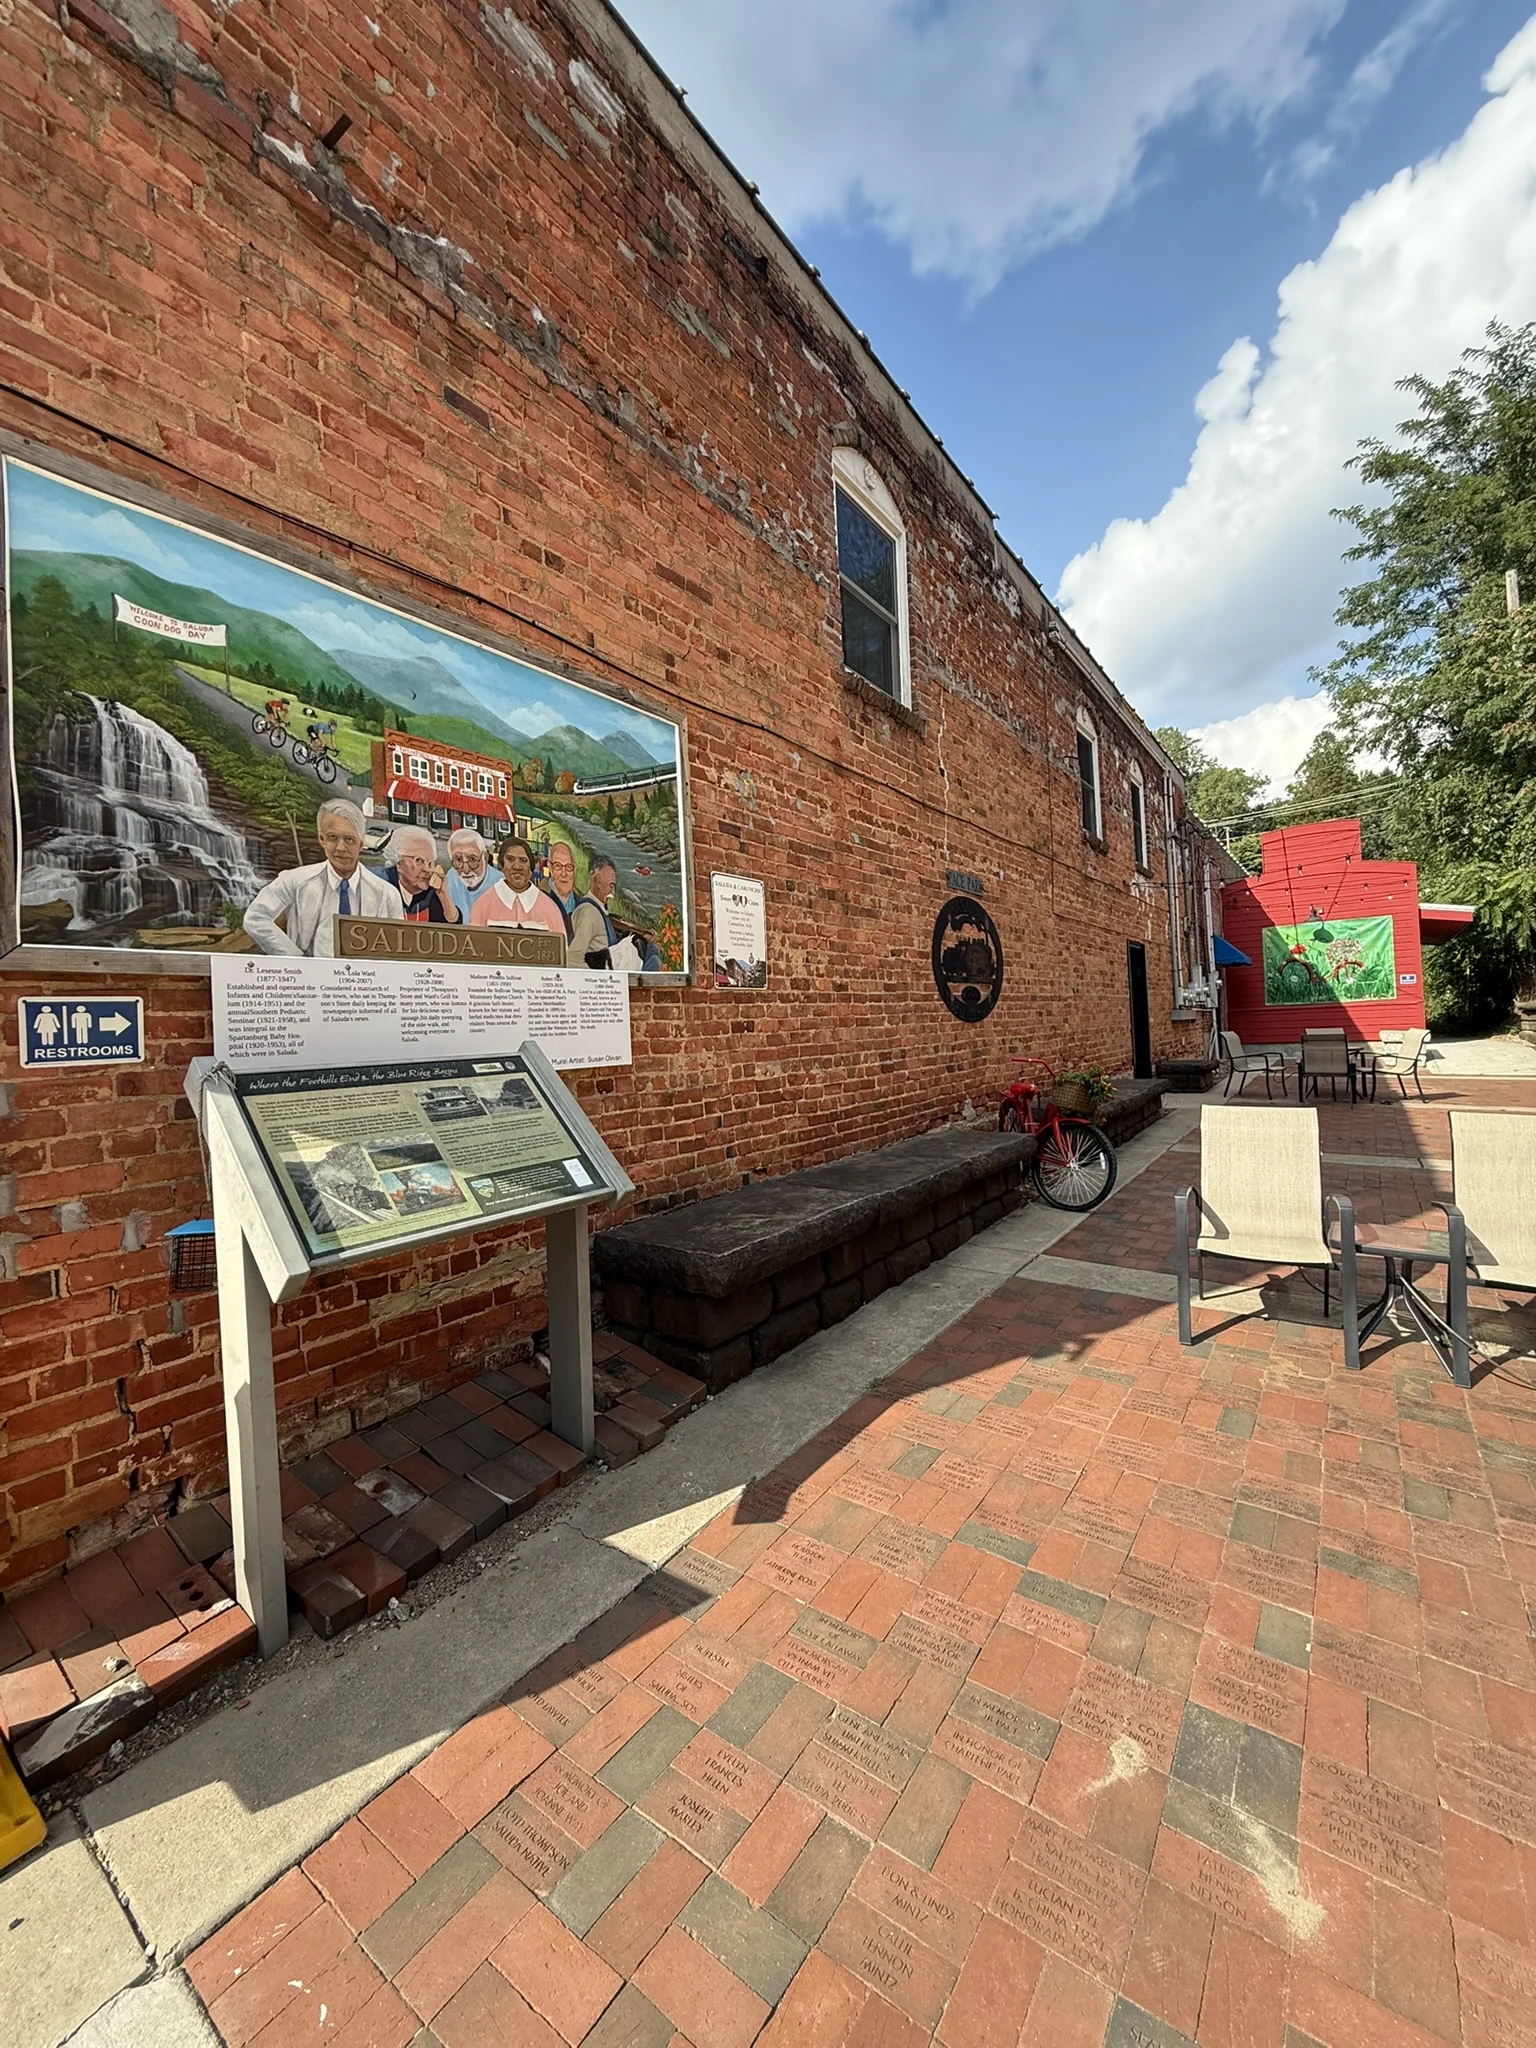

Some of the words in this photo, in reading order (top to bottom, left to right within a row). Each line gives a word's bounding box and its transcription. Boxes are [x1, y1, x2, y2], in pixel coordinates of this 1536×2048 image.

[129, 604, 164, 622] WELCOME
[170, 619, 178, 627] TO
[182, 622, 214, 633] SALUDA
[134, 615, 161, 630] COON
[164, 625, 181, 635] DOG
[188, 631, 206, 640] DAY
[950, 871, 966, 888] PACE
[967, 874, 984, 893] PARK
[349, 924, 485, 961] SALUDA,
[498, 935, 535, 961] NC
[243, 1025, 268, 1033] integral
[34, 1044, 134, 1059] RESTROOMS
[229, 1050, 250, 1058] which
[587, 1055, 604, 1063] Susan
[250, 1077, 278, 1090] Where
[282, 1076, 296, 1088] the
[300, 1075, 338, 1086] Foothills
[340, 1072, 361, 1083] End
[373, 1070, 384, 1080] the
[387, 1069, 407, 1080] Blue
[408, 1067, 431, 1080] Ridge
[432, 1066, 458, 1078] Begins
[798, 1575, 817, 1587] ROSS
[925, 1592, 935, 1600] IN
[934, 1596, 971, 1615] MEMORY
[971, 1613, 983, 1621] OF
[819, 1616, 828, 1625] IN
[828, 1621, 864, 1640] MEMORY
[828, 1631, 840, 1640] OF
[906, 1622, 937, 1639] THANKS
[940, 1635, 951, 1646] TO
[952, 1642, 967, 1652] THE
[809, 1651, 849, 1675] MORGAN
[820, 1637, 863, 1662] CALLAWAY
[1248, 1653, 1288, 1674] FOSTER
[675, 1682, 688, 1693] OF
[1210, 1675, 1244, 1693] JAMES
[1247, 1688, 1288, 1710] FOSTER
[1212, 1685, 1231, 1698] FEB
[1252, 1701, 1281, 1718] 2002
[680, 1699, 698, 1714] SOS
[970, 1695, 982, 1705] IN
[982, 1702, 1024, 1724] MEMORY
[1078, 1697, 1098, 1711] NEIL
[1105, 1708, 1132, 1726] NESS
[1138, 1723, 1165, 1740] COLE
[1217, 1696, 1250, 1717] SMITH
[1253, 1711, 1276, 1727] HILL
[837, 1712, 862, 1731] GENE
[862, 1729, 885, 1743] AND
[885, 1741, 911, 1760] MARY
[1072, 1705, 1115, 1729] LINDSAY
[1157, 1743, 1168, 1754] G
[716, 1749, 750, 1775] EVELYN
[841, 1729, 893, 1764] LIMEHOUSE
[944, 1740, 995, 1770] CHARLENE
[996, 1766, 1021, 1785] PACE
[953, 1731, 965, 1742] IN
[966, 1737, 1006, 1763] HONOR
[1007, 1758, 1022, 1770] OF
[701, 1771, 730, 1796] HELEN
[704, 1757, 744, 1787] FRANCES
[815, 1751, 841, 1771] SALLY
[840, 1768, 864, 1788] AND
[1309, 1756, 1366, 1786] GEORGE
[1370, 1783, 1380, 1794] &
[553, 1782, 570, 1799] JOE
[569, 1796, 589, 1814] AND
[562, 1771, 597, 1800] MEMORY
[596, 1796, 612, 1810] OF
[795, 1772, 829, 1799] SALUDA
[858, 1813, 875, 1830] SC
[832, 1778, 848, 1794] LEE
[1344, 1783, 1389, 1810] SWEET
[532, 1786, 567, 1817] JOANNE
[564, 1811, 585, 1834] WAY
[667, 1805, 704, 1833] MARLEY
[678, 1793, 714, 1822] JOSEPH
[1332, 1791, 1373, 1816] SMITH
[1377, 1810, 1403, 1829] HILL
[498, 1803, 526, 1828] LLOYD
[522, 1823, 571, 1870] THOMPSON
[1321, 1806, 1365, 1833] SCOTT
[1371, 1830, 1417, 1858] SWEET
[492, 1820, 523, 1853] SALUDA
[521, 1847, 551, 1878] NATIVE
[1025, 1816, 1059, 1840] MARY
[1119, 1868, 1143, 1890] PYE
[1045, 1842, 1091, 1877] SALUDA
[1331, 1839, 1374, 1867] SMITH
[1379, 1862, 1406, 1883] HILL
[1030, 1851, 1066, 1880] TRAIN
[1197, 1852, 1247, 1885] PATRICK
[880, 1865, 910, 1891] DON
[910, 1885, 919, 1900] &
[921, 1893, 956, 1924] LINDA
[1198, 1869, 1242, 1901] HENRY
[891, 1894, 929, 1926] MINTZ
[1028, 1879, 1075, 1914] LUCIAN
[1076, 1907, 1100, 1929] PYE
[1189, 1881, 1247, 1922] NELSON
[994, 1896, 1067, 1947] HONORARY
[1071, 1943, 1117, 1981] LOCAL
[1027, 1897, 1068, 1930] CHINA
[1073, 1923, 1105, 1952] 1921
[877, 1924, 916, 1958] CALLIE
[858, 1956, 899, 1991] MINTZ
